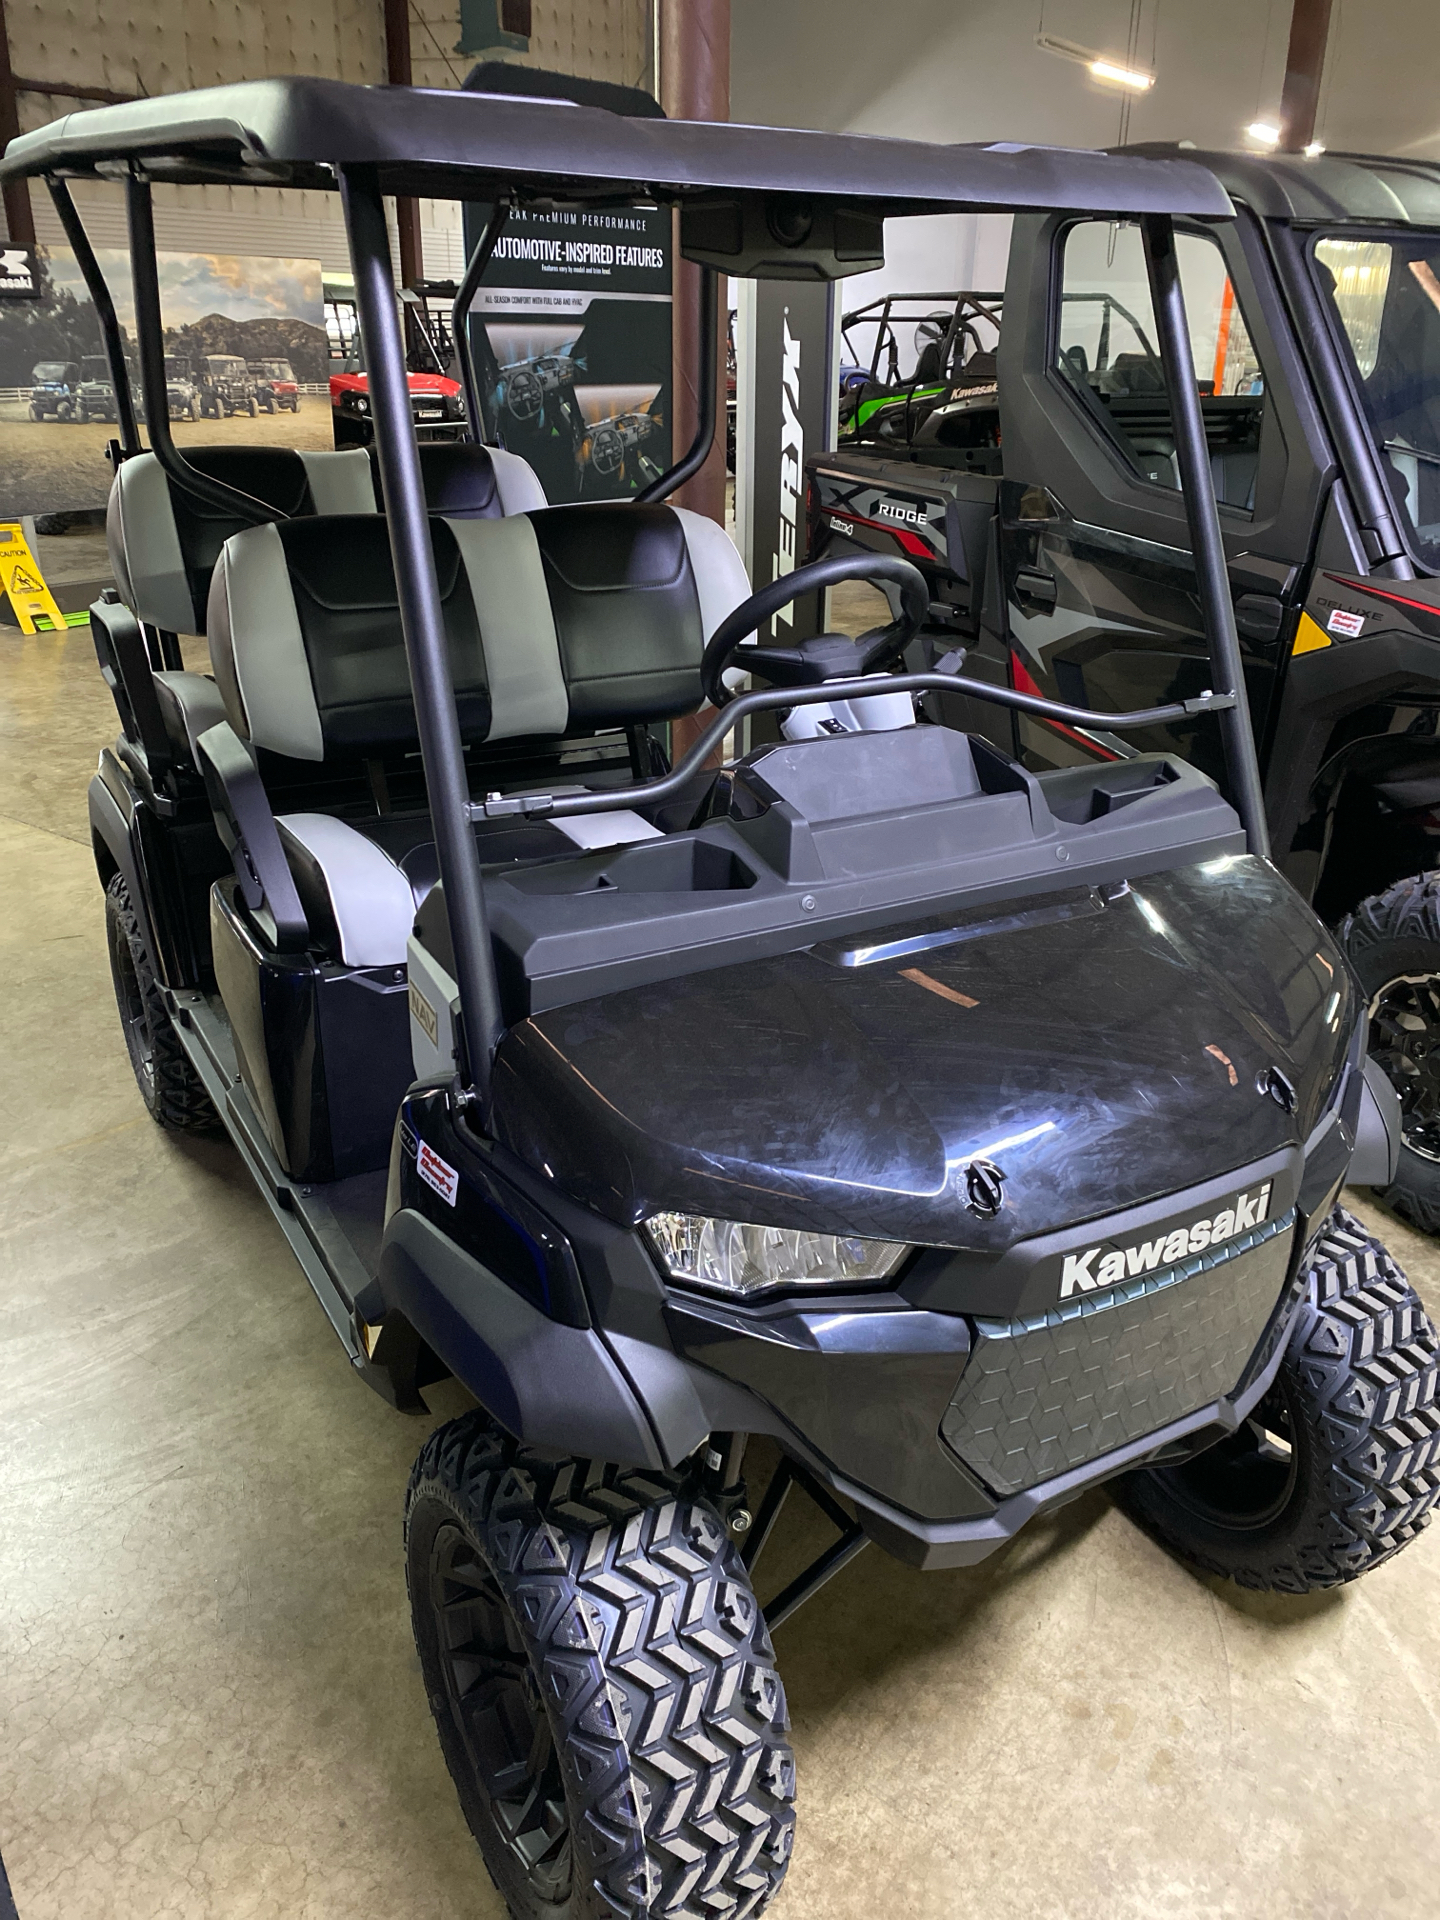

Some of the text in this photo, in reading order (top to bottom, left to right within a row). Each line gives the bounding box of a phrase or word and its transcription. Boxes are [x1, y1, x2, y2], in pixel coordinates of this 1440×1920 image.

[510, 209, 528, 220] EAK
[582, 214, 647, 232] PERFORMANCE
[491, 237, 663, 268] AUTOMOTIVE-INSPIRED FEATURES
[541, 263, 559, 272] Features
[511, 296, 532, 305] COMFORT
[532, 296, 543, 305] WITH
[543, 297, 553, 306] FULL
[553, 297, 563, 306] CAB
[563, 298, 571, 306] AND
[572, 298, 583, 307] HVAC
[950, 382, 998, 400] Kawasak
[878, 503, 928, 525] RIDGE
[0, 549, 27, 558] CAUTION
[1315, 597, 1384, 621] DELUXE
[411, 989, 435, 1034] NAV
[1060, 1183, 1271, 1297] Kawasaki
